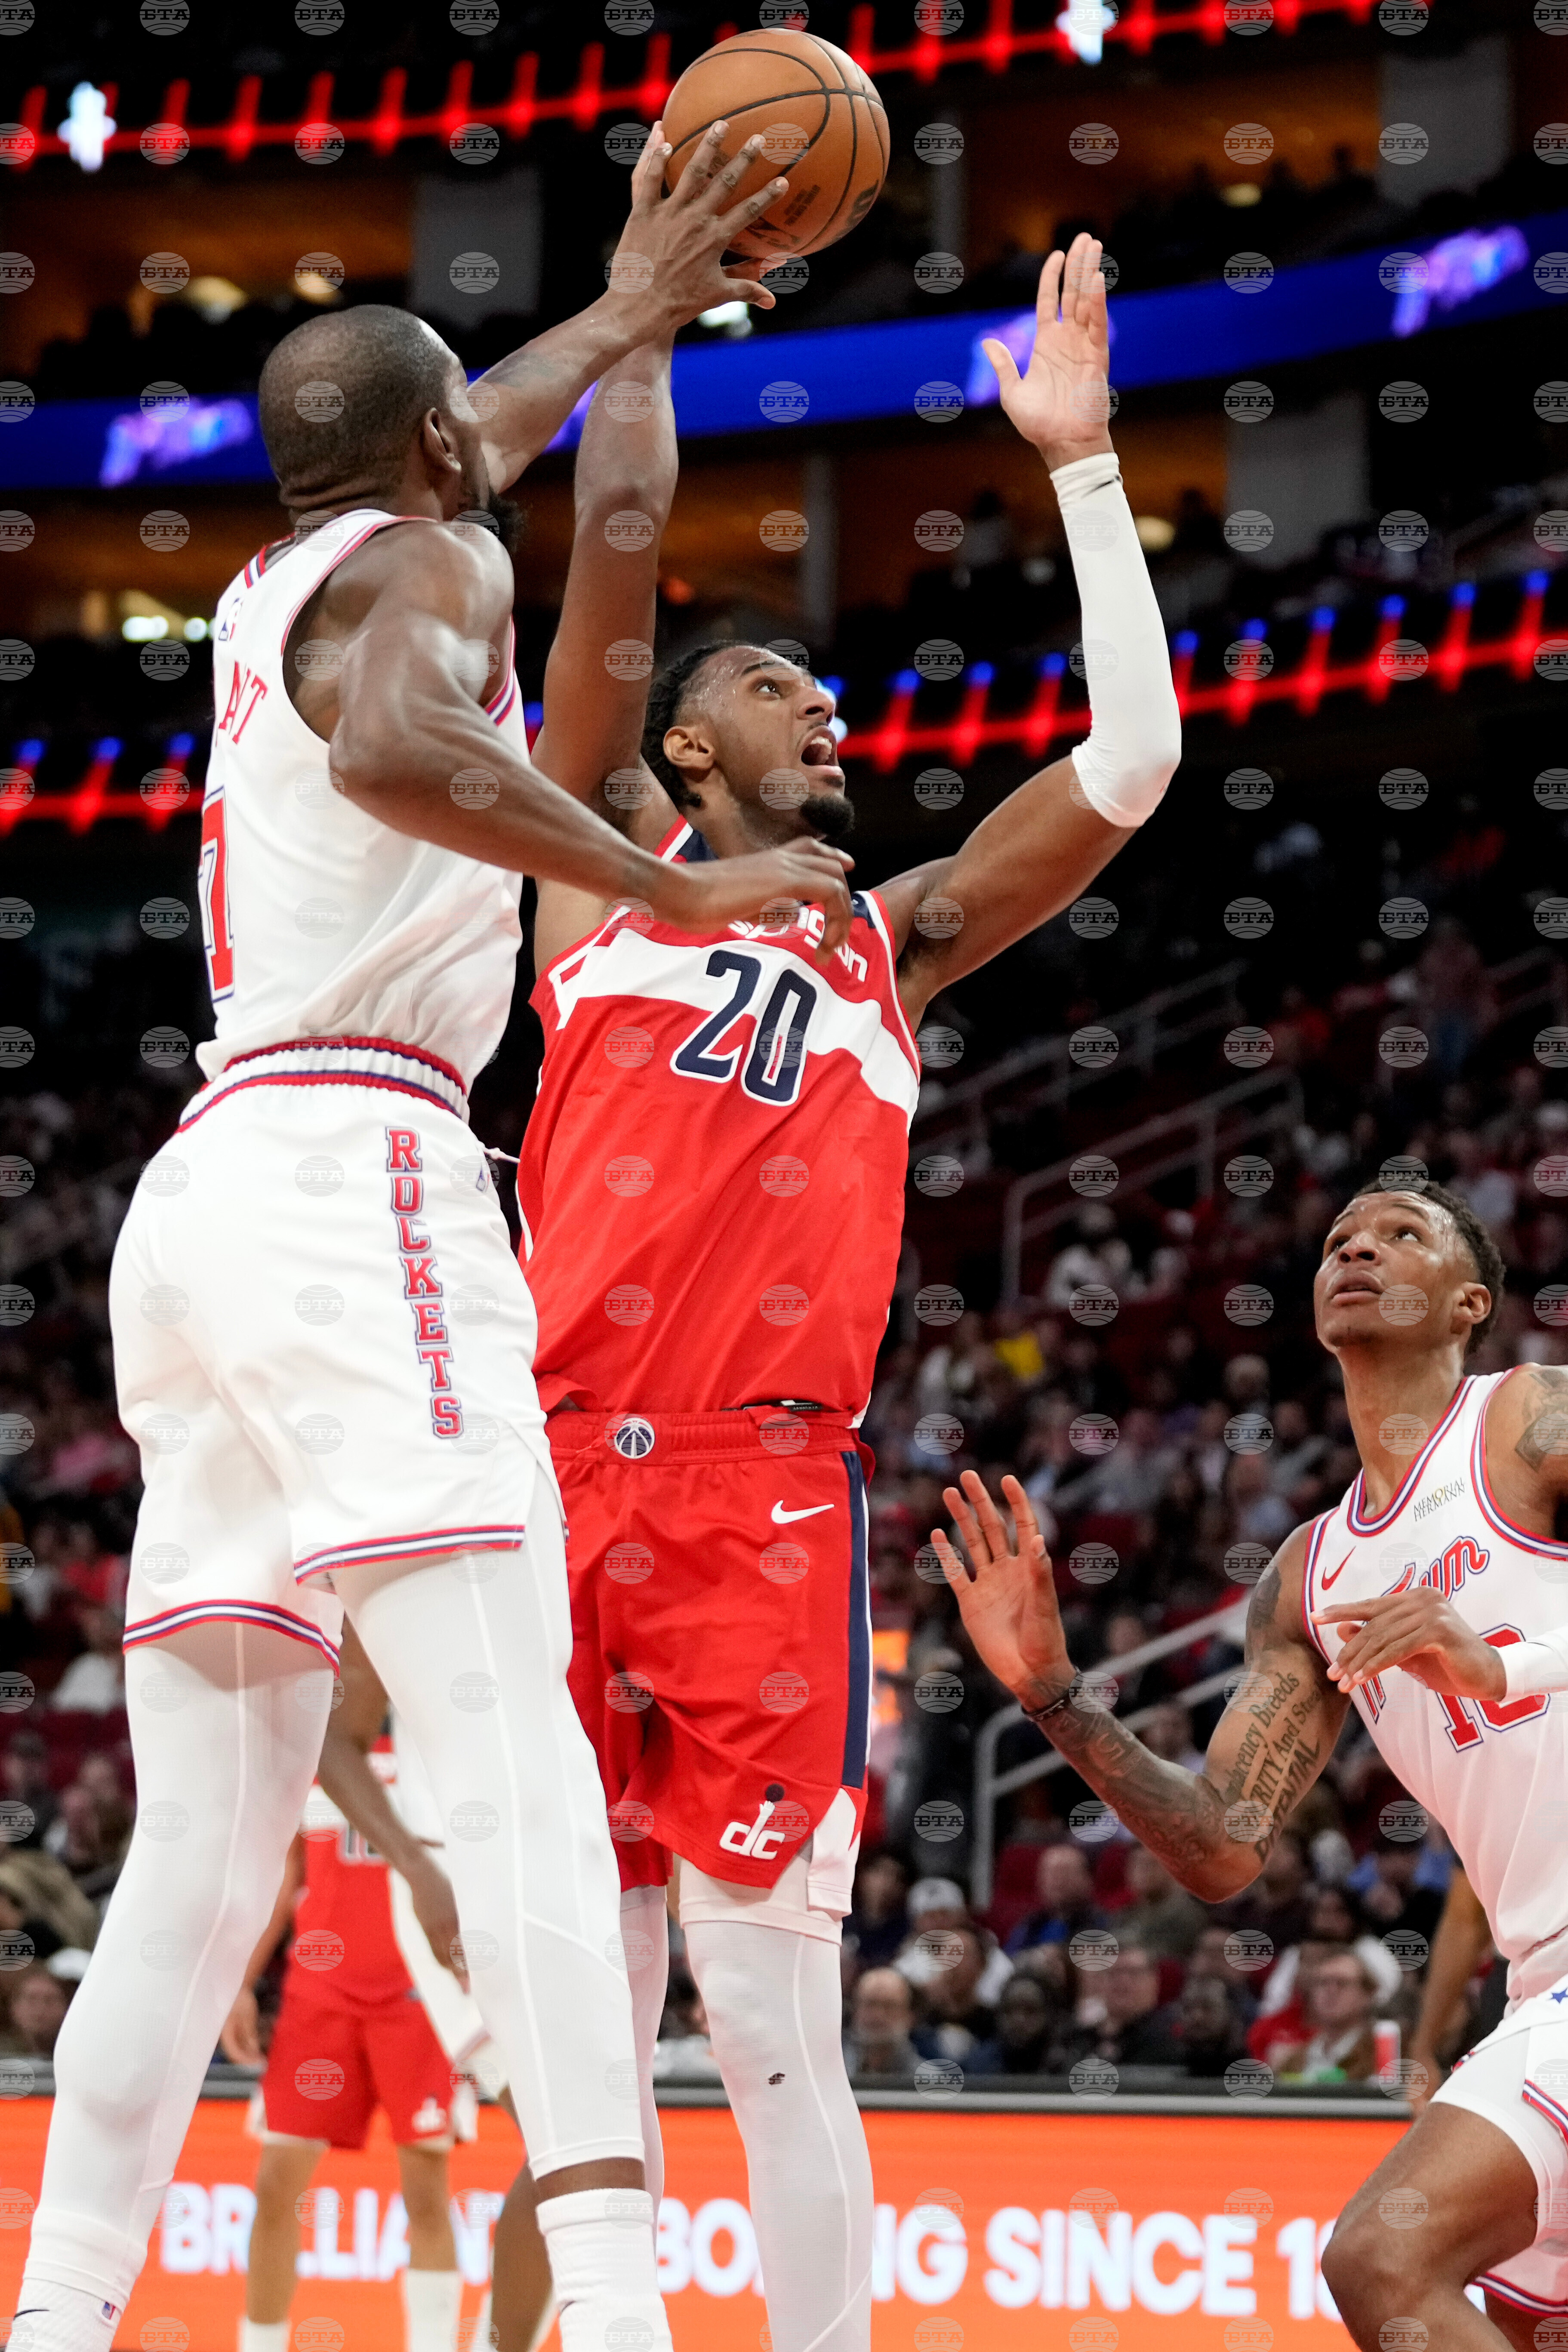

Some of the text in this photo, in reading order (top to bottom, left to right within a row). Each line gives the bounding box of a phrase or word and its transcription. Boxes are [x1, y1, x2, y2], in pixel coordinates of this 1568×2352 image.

[669, 949, 817, 1106] 20
[385, 1126, 464, 1439] ROCKETS
[720, 1801, 786, 1859] dc
[983, 2207, 1257, 2317] SINCE
